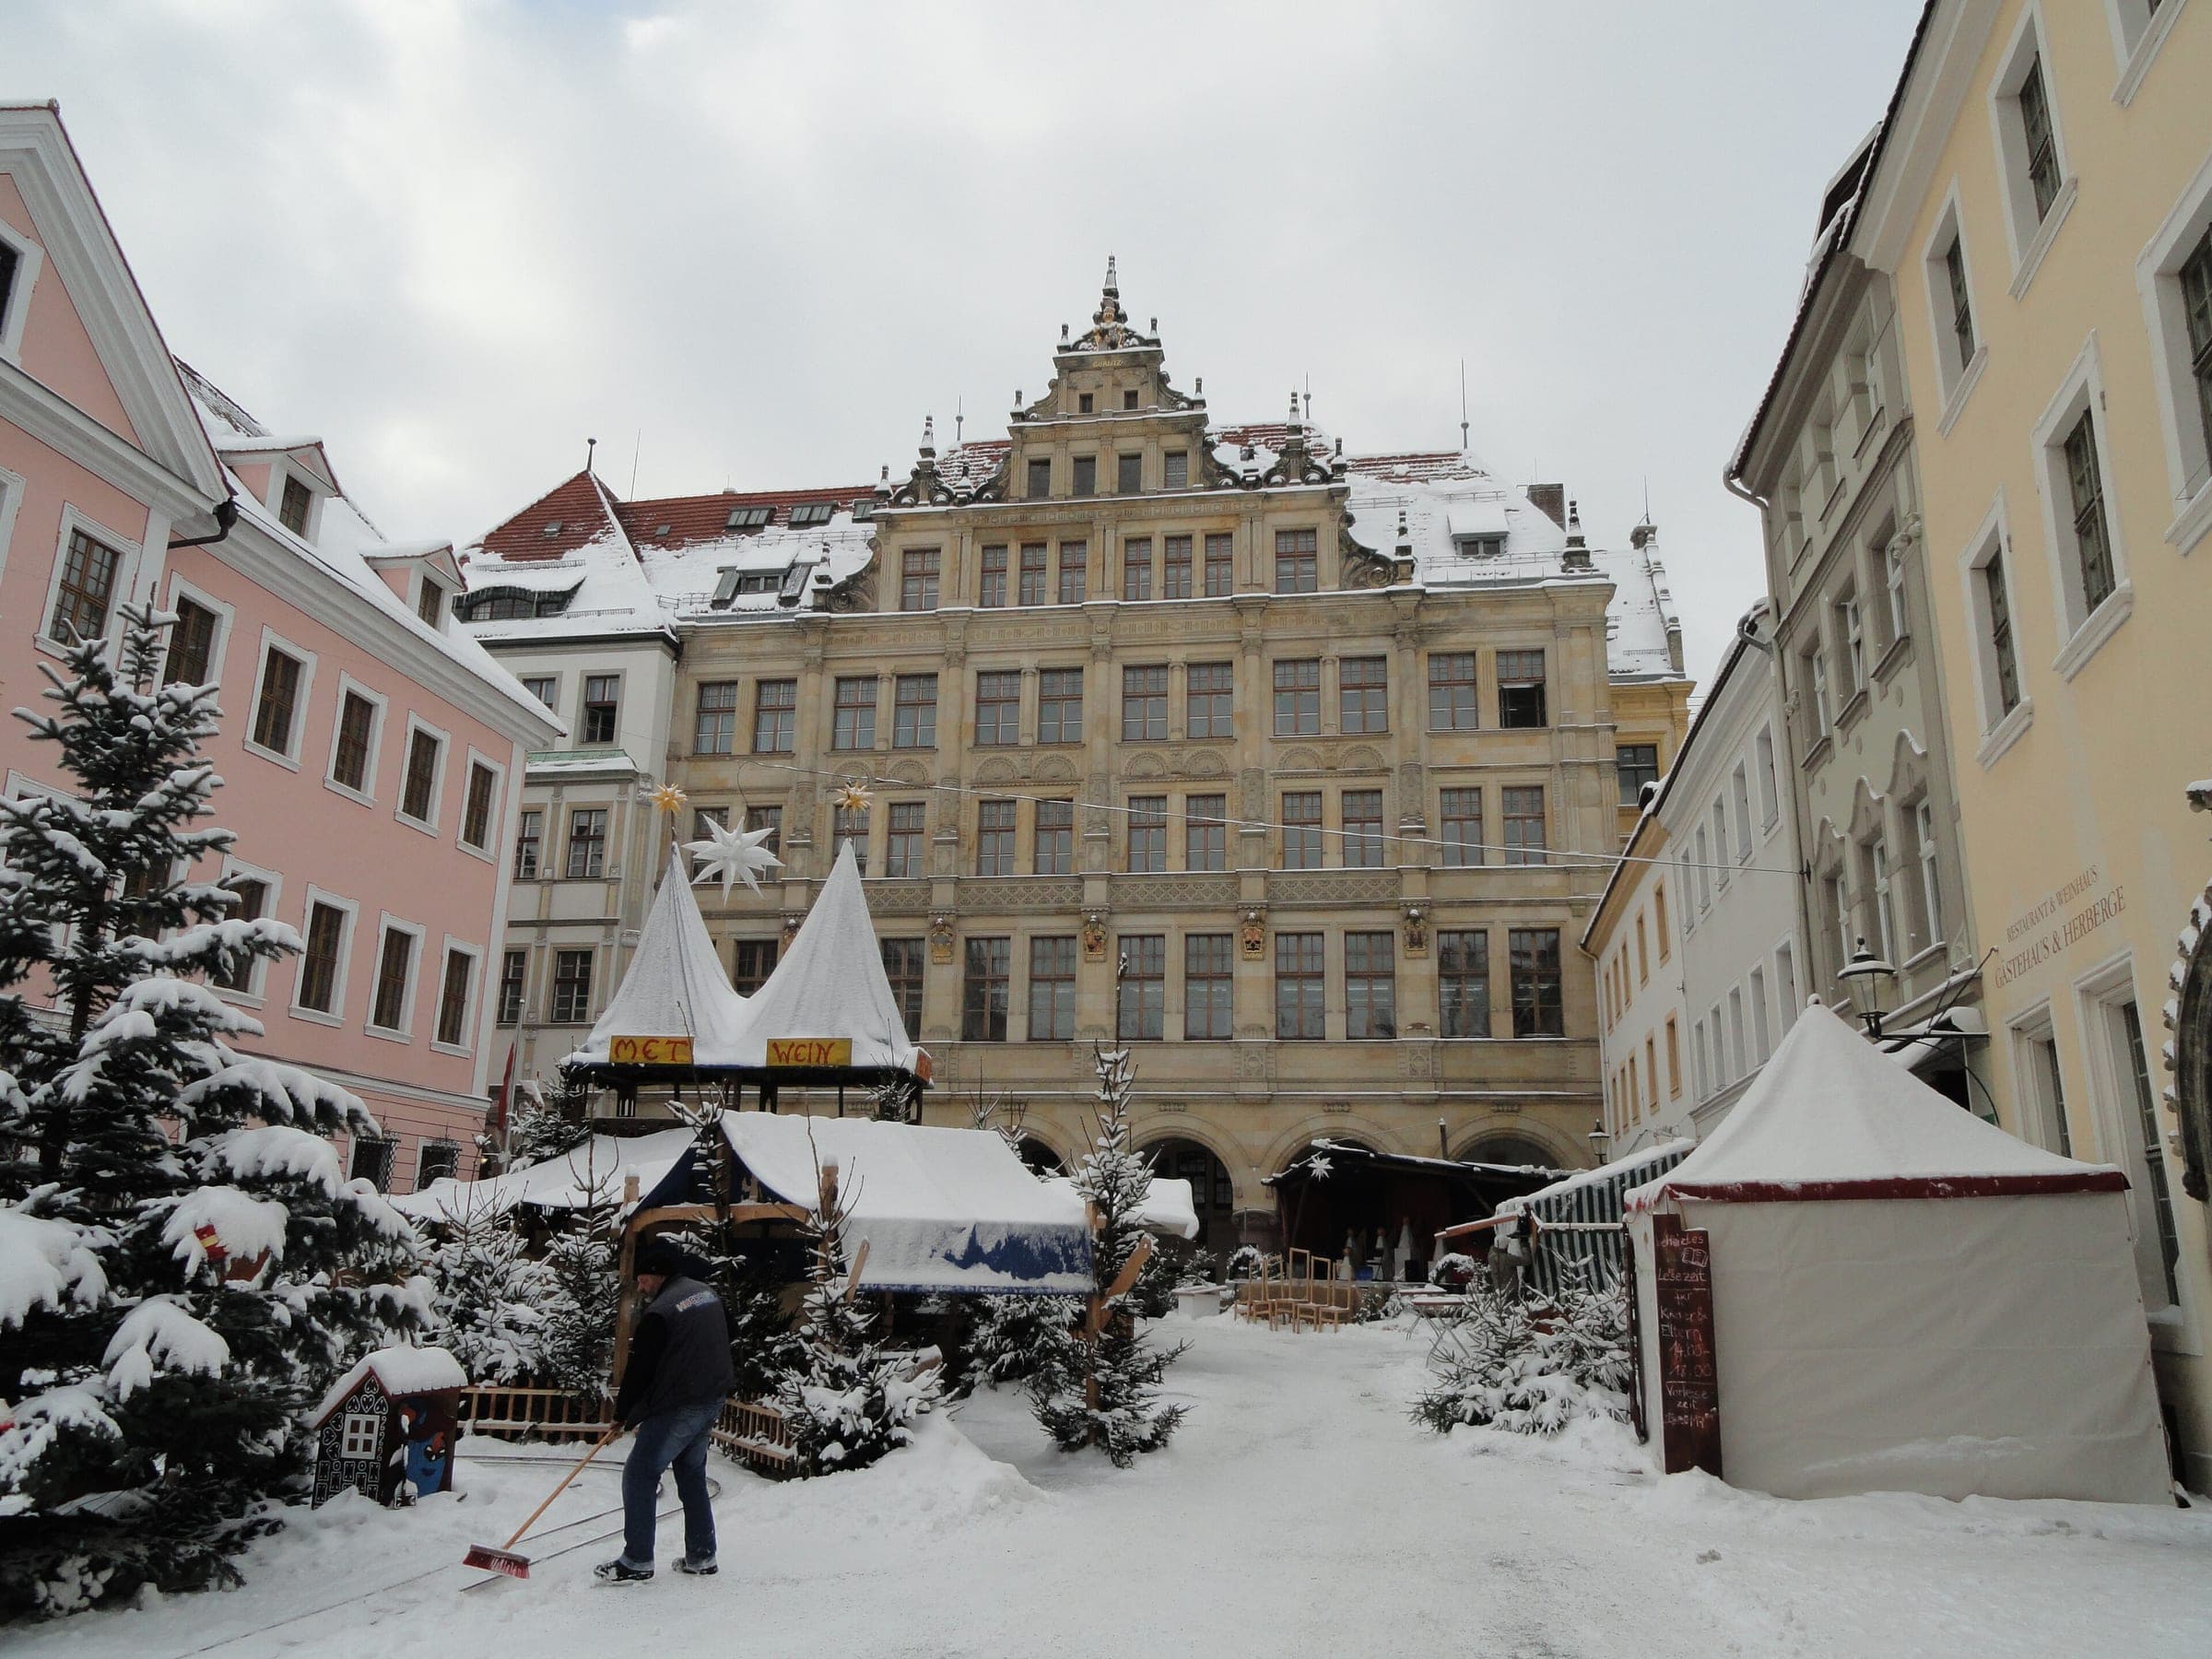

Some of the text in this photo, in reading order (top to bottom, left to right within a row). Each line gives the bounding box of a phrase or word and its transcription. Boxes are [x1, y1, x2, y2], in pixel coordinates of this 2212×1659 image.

[2055, 864, 2099, 906] WEINHAUS
[2052, 930, 2062, 954] &
[2063, 886, 2126, 947] HERBERGE
[615, 1038, 689, 1062] MET
[772, 1041, 835, 1065] WEIN
